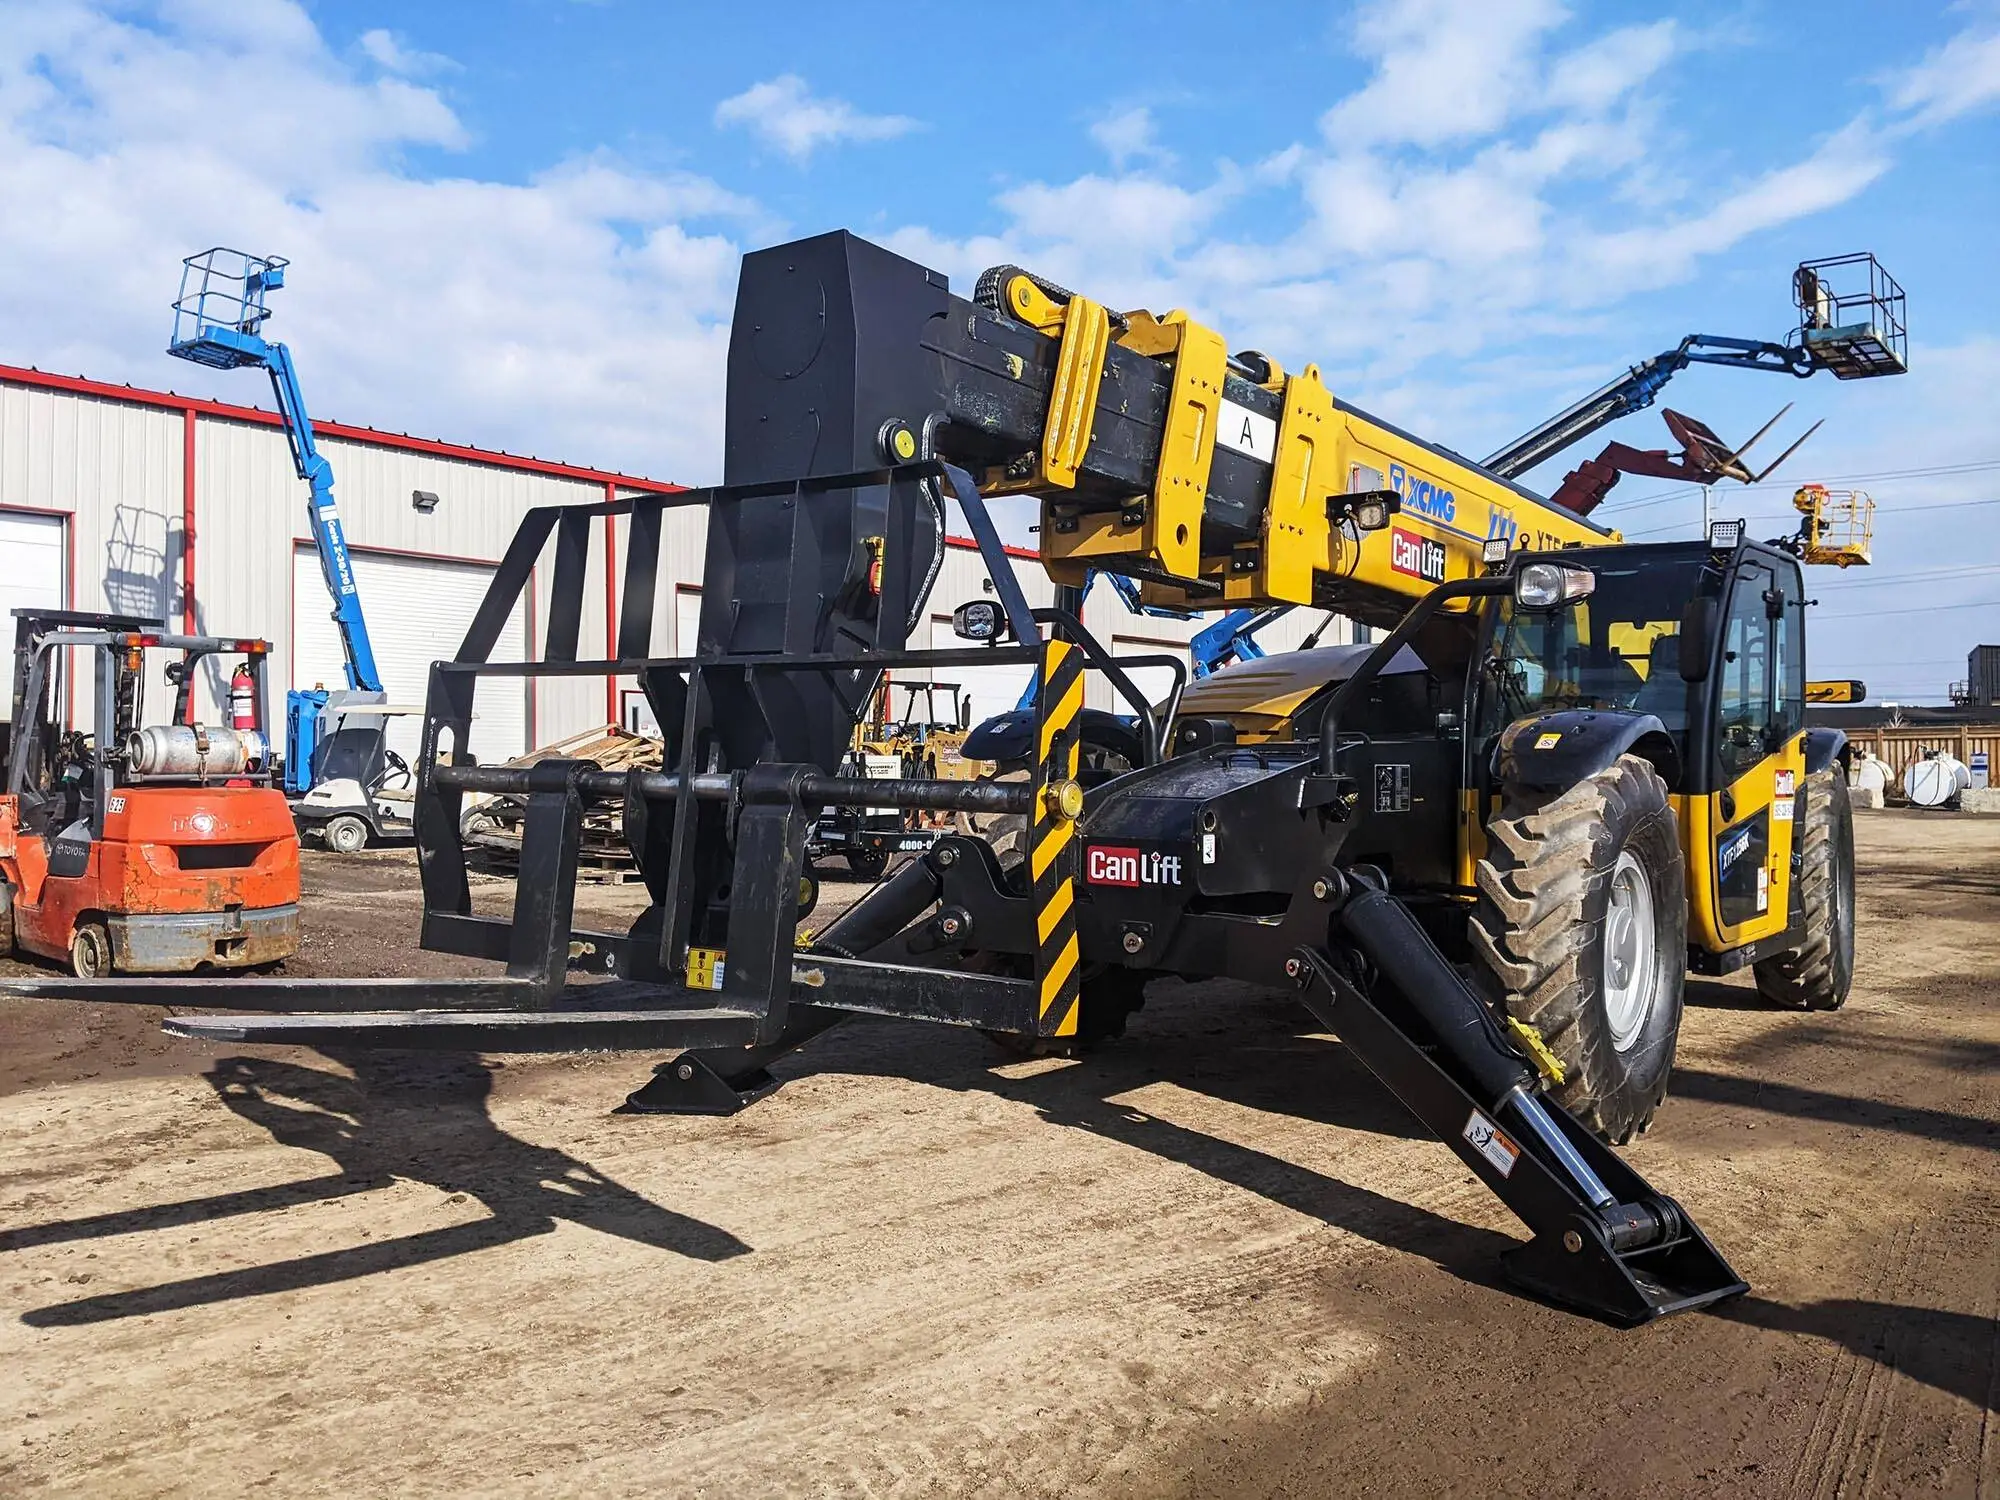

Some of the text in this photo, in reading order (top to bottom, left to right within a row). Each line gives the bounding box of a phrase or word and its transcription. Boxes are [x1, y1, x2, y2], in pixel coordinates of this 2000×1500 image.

[1240, 416, 1253, 449] A
[1405, 474, 1455, 522] XCMG
[64, 845, 86, 857] TOYOTA
